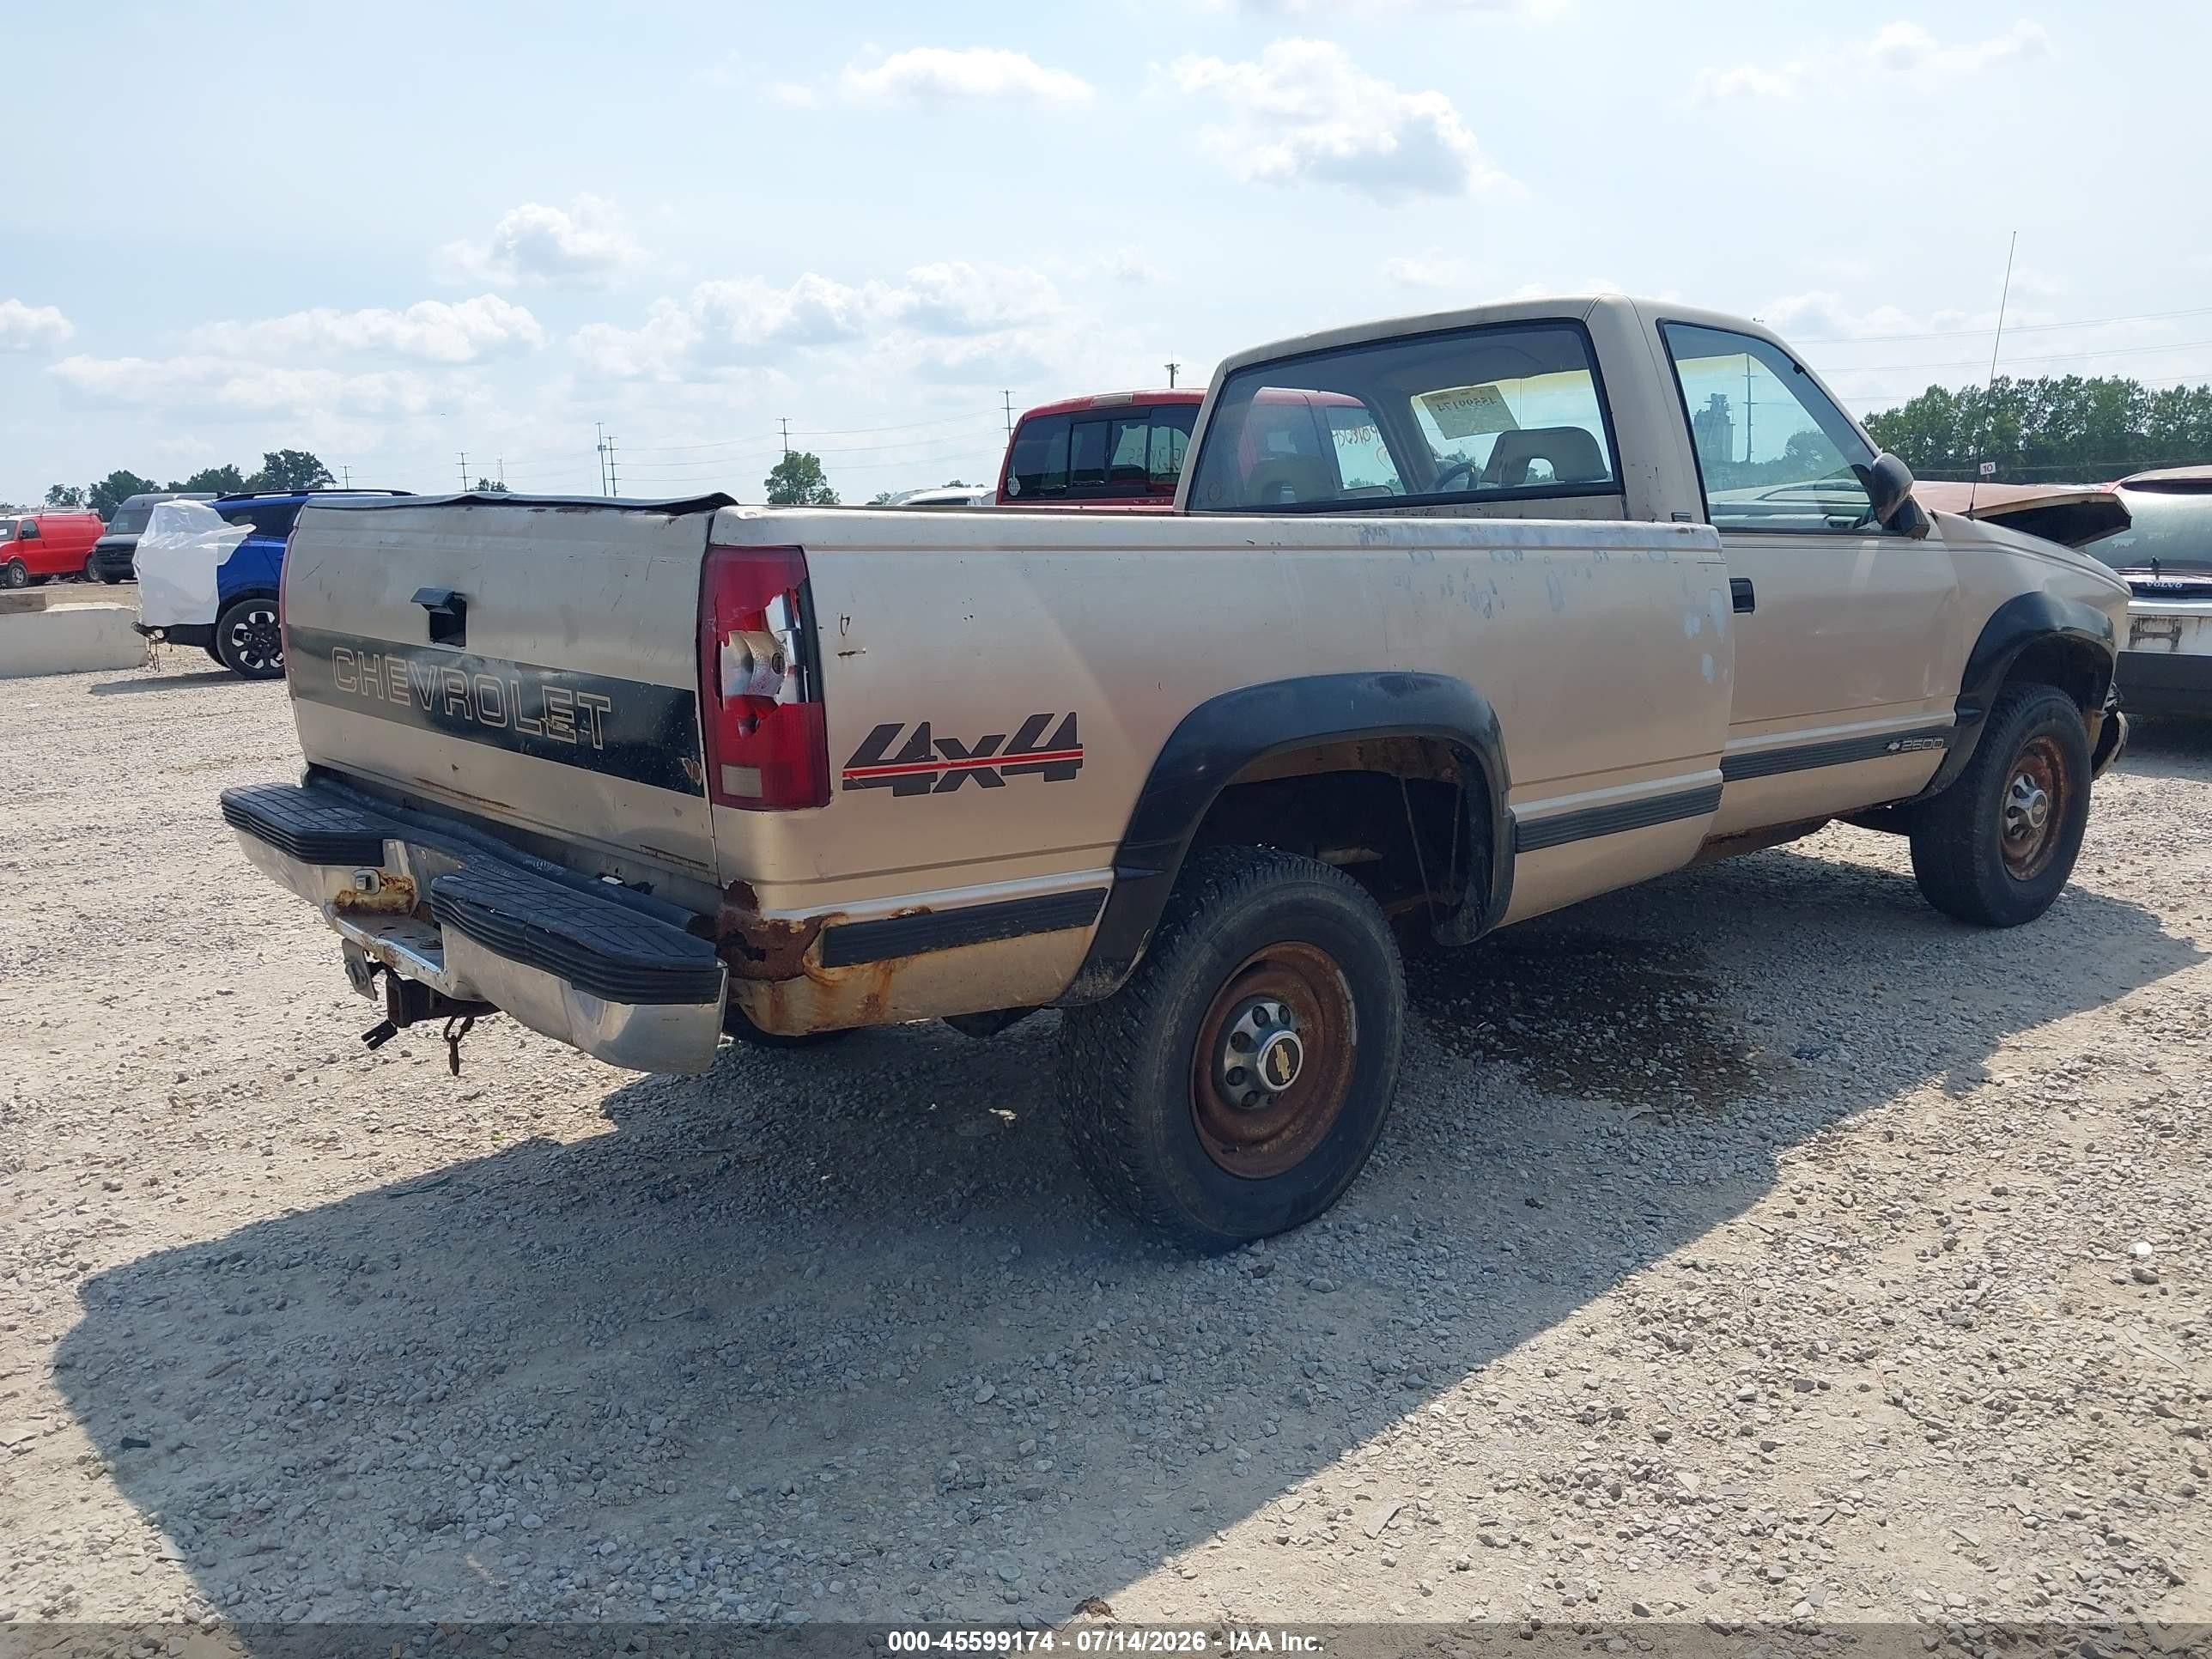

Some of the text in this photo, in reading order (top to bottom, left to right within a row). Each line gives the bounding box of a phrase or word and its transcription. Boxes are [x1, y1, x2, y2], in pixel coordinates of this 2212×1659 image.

[1984, 464, 1993, 472] 10
[331, 646, 611, 750] CHEVROLET
[1901, 738, 1944, 750] 2500
